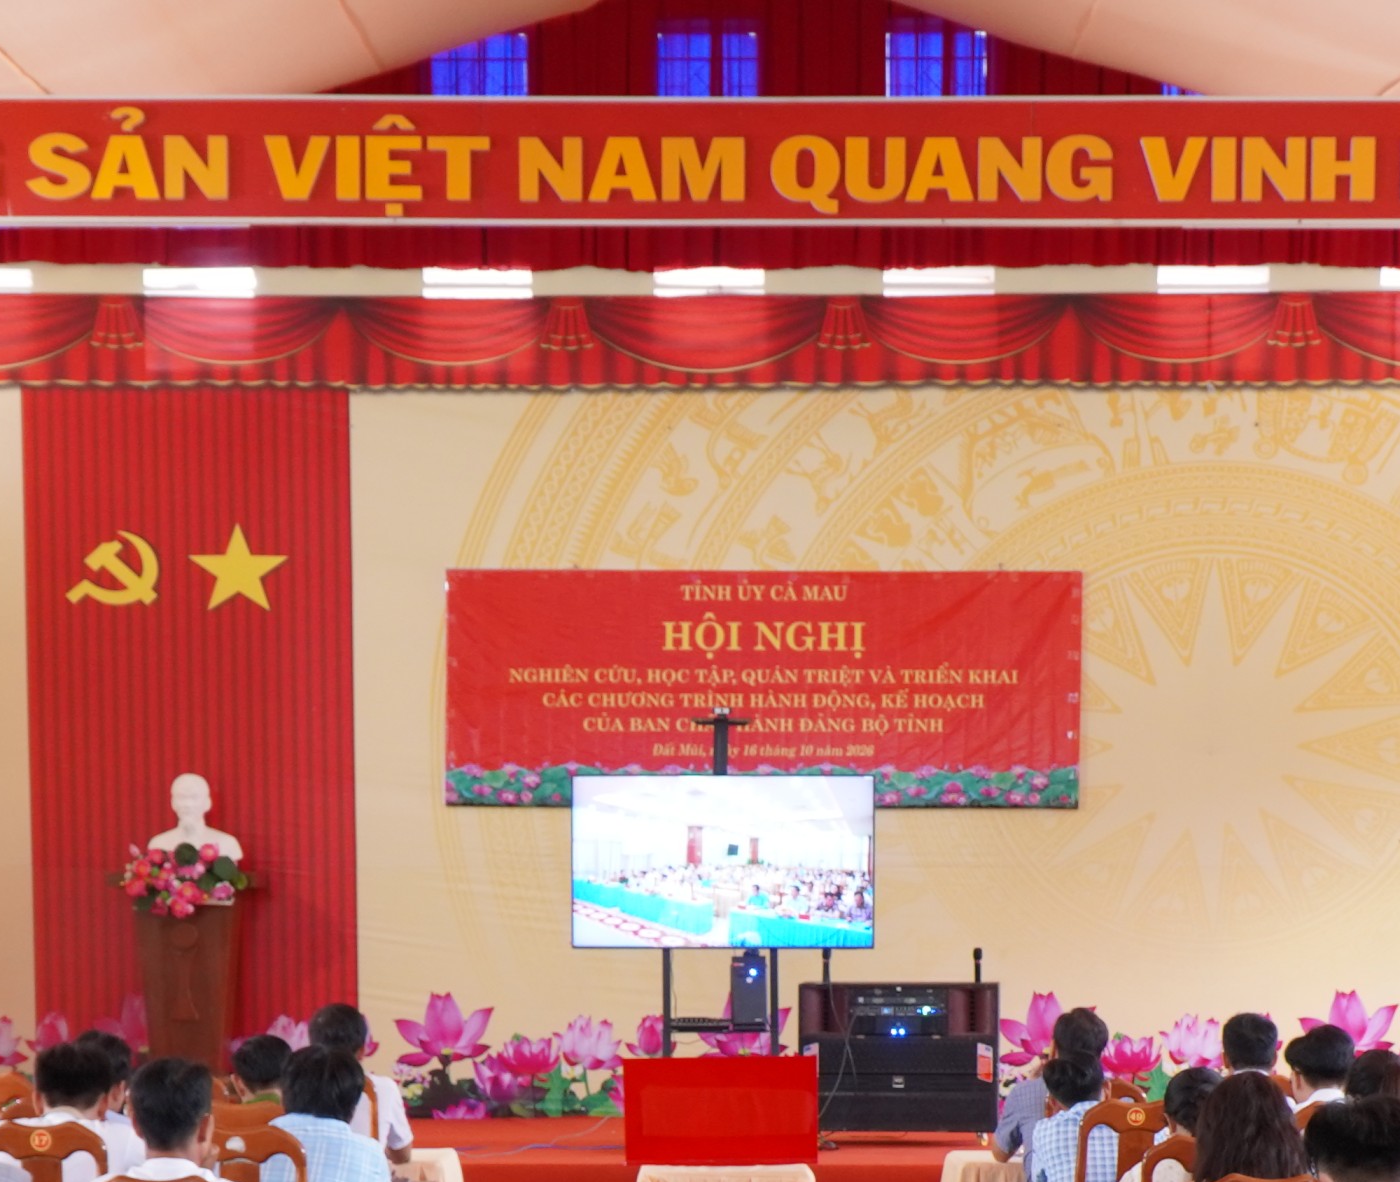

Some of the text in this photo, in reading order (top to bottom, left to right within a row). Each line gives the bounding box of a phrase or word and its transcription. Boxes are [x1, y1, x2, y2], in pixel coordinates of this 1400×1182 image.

[25, 106, 233, 202] SẢN
[263, 115, 492, 217] VIỆT
[519, 135, 747, 202] NAM
[770, 133, 1114, 214] QUANG
[1139, 135, 1377, 203] VINH
[680, 578, 847, 601] TỈNH ỦY CÀ MAU
[663, 612, 865, 659] HỘI NGHỊ
[510, 662, 1018, 687] NGHIÊN CỨU, HỌC TẬP, QUÁN TRIỆT VÀ TRIỂN KHAI
[542, 689, 984, 712] CÁC CHƯƠNG TRÌNH HÀNH ĐỘNG, KẾ HOẠCH
[583, 713, 624, 732] CỦA
[630, 717, 670, 732] BAN
[799, 713, 856, 733] ĐẢNG
[861, 714, 890, 736] BỘ
[893, 713, 943, 733] TỈNH
[1129, 1112, 1144, 1122] 49
